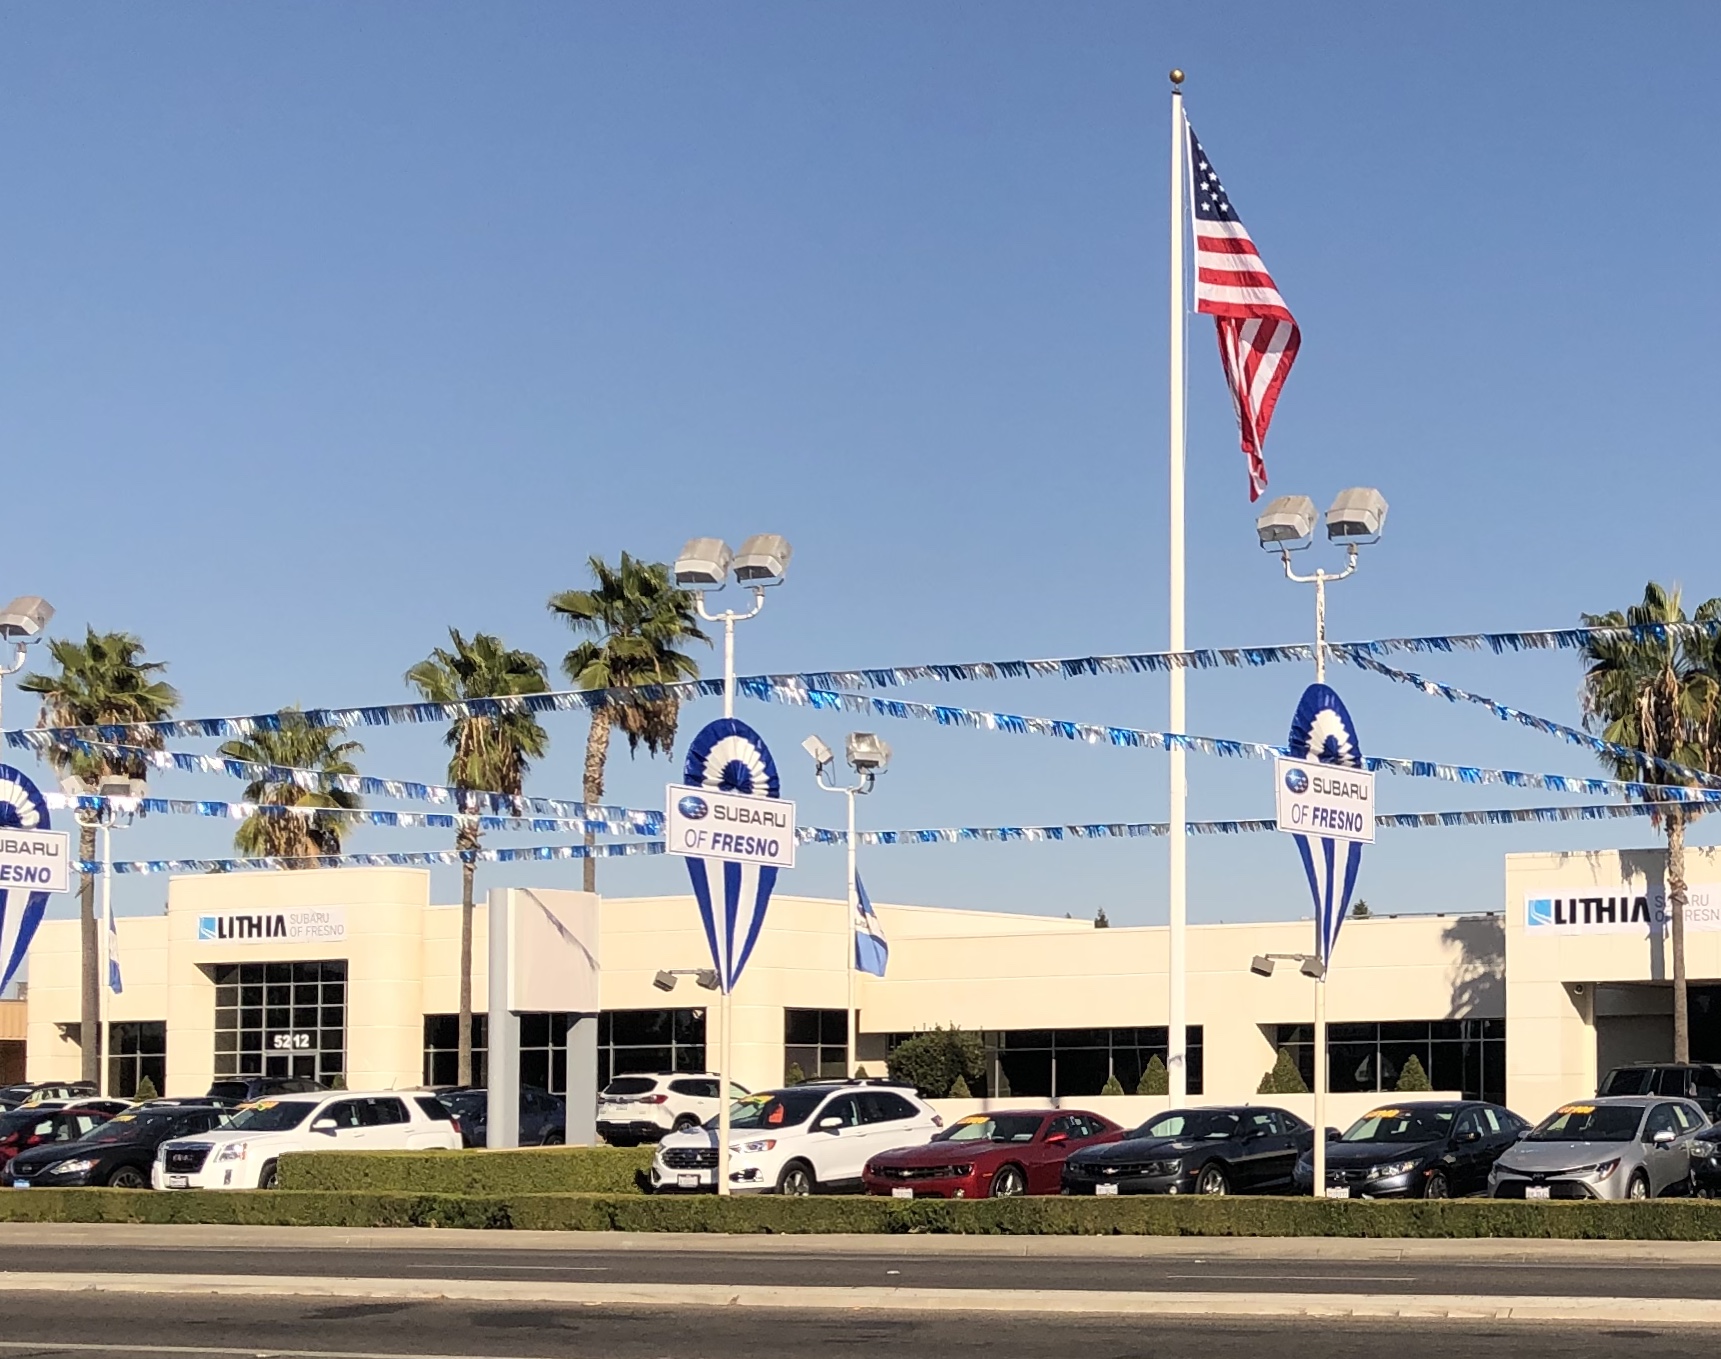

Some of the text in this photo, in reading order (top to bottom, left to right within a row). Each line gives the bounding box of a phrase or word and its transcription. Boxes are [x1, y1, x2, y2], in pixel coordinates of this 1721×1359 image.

[1313, 777, 1368, 800] SUBARU
[714, 804, 786, 828] SUBARU
[1291, 803, 1363, 832] OF FRESNO
[684, 829, 780, 857] OF FRESNO
[1554, 897, 1651, 925] LITHIA
[218, 913, 330, 939] LITHIA SUBARU
[289, 925, 345, 938] OF FRESNO
[274, 1034, 310, 1048] 5212
